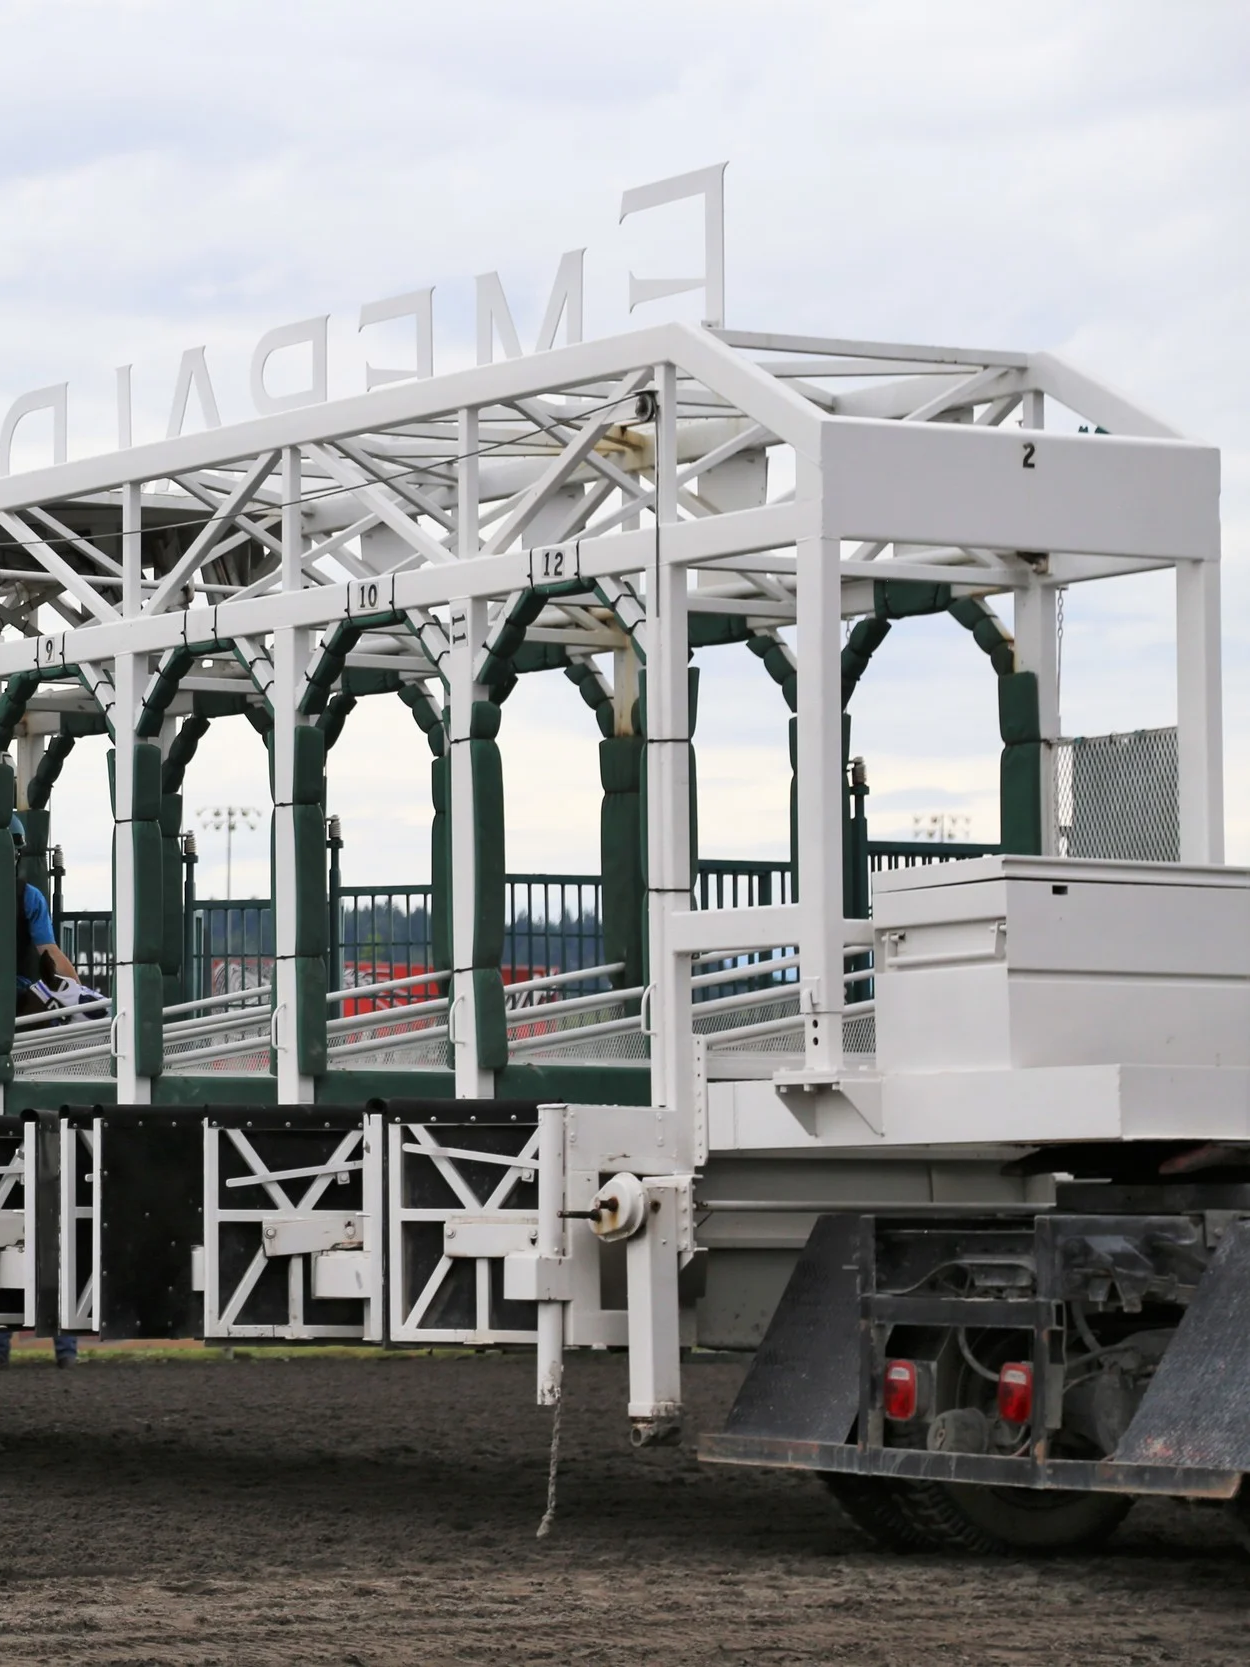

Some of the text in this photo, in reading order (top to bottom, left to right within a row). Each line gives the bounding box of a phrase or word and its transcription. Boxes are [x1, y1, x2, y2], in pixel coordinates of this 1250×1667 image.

[1022, 442, 1036, 469] 2
[543, 552, 564, 576] 12
[359, 584, 378, 608] 10
[45, 639, 53, 661] 9
